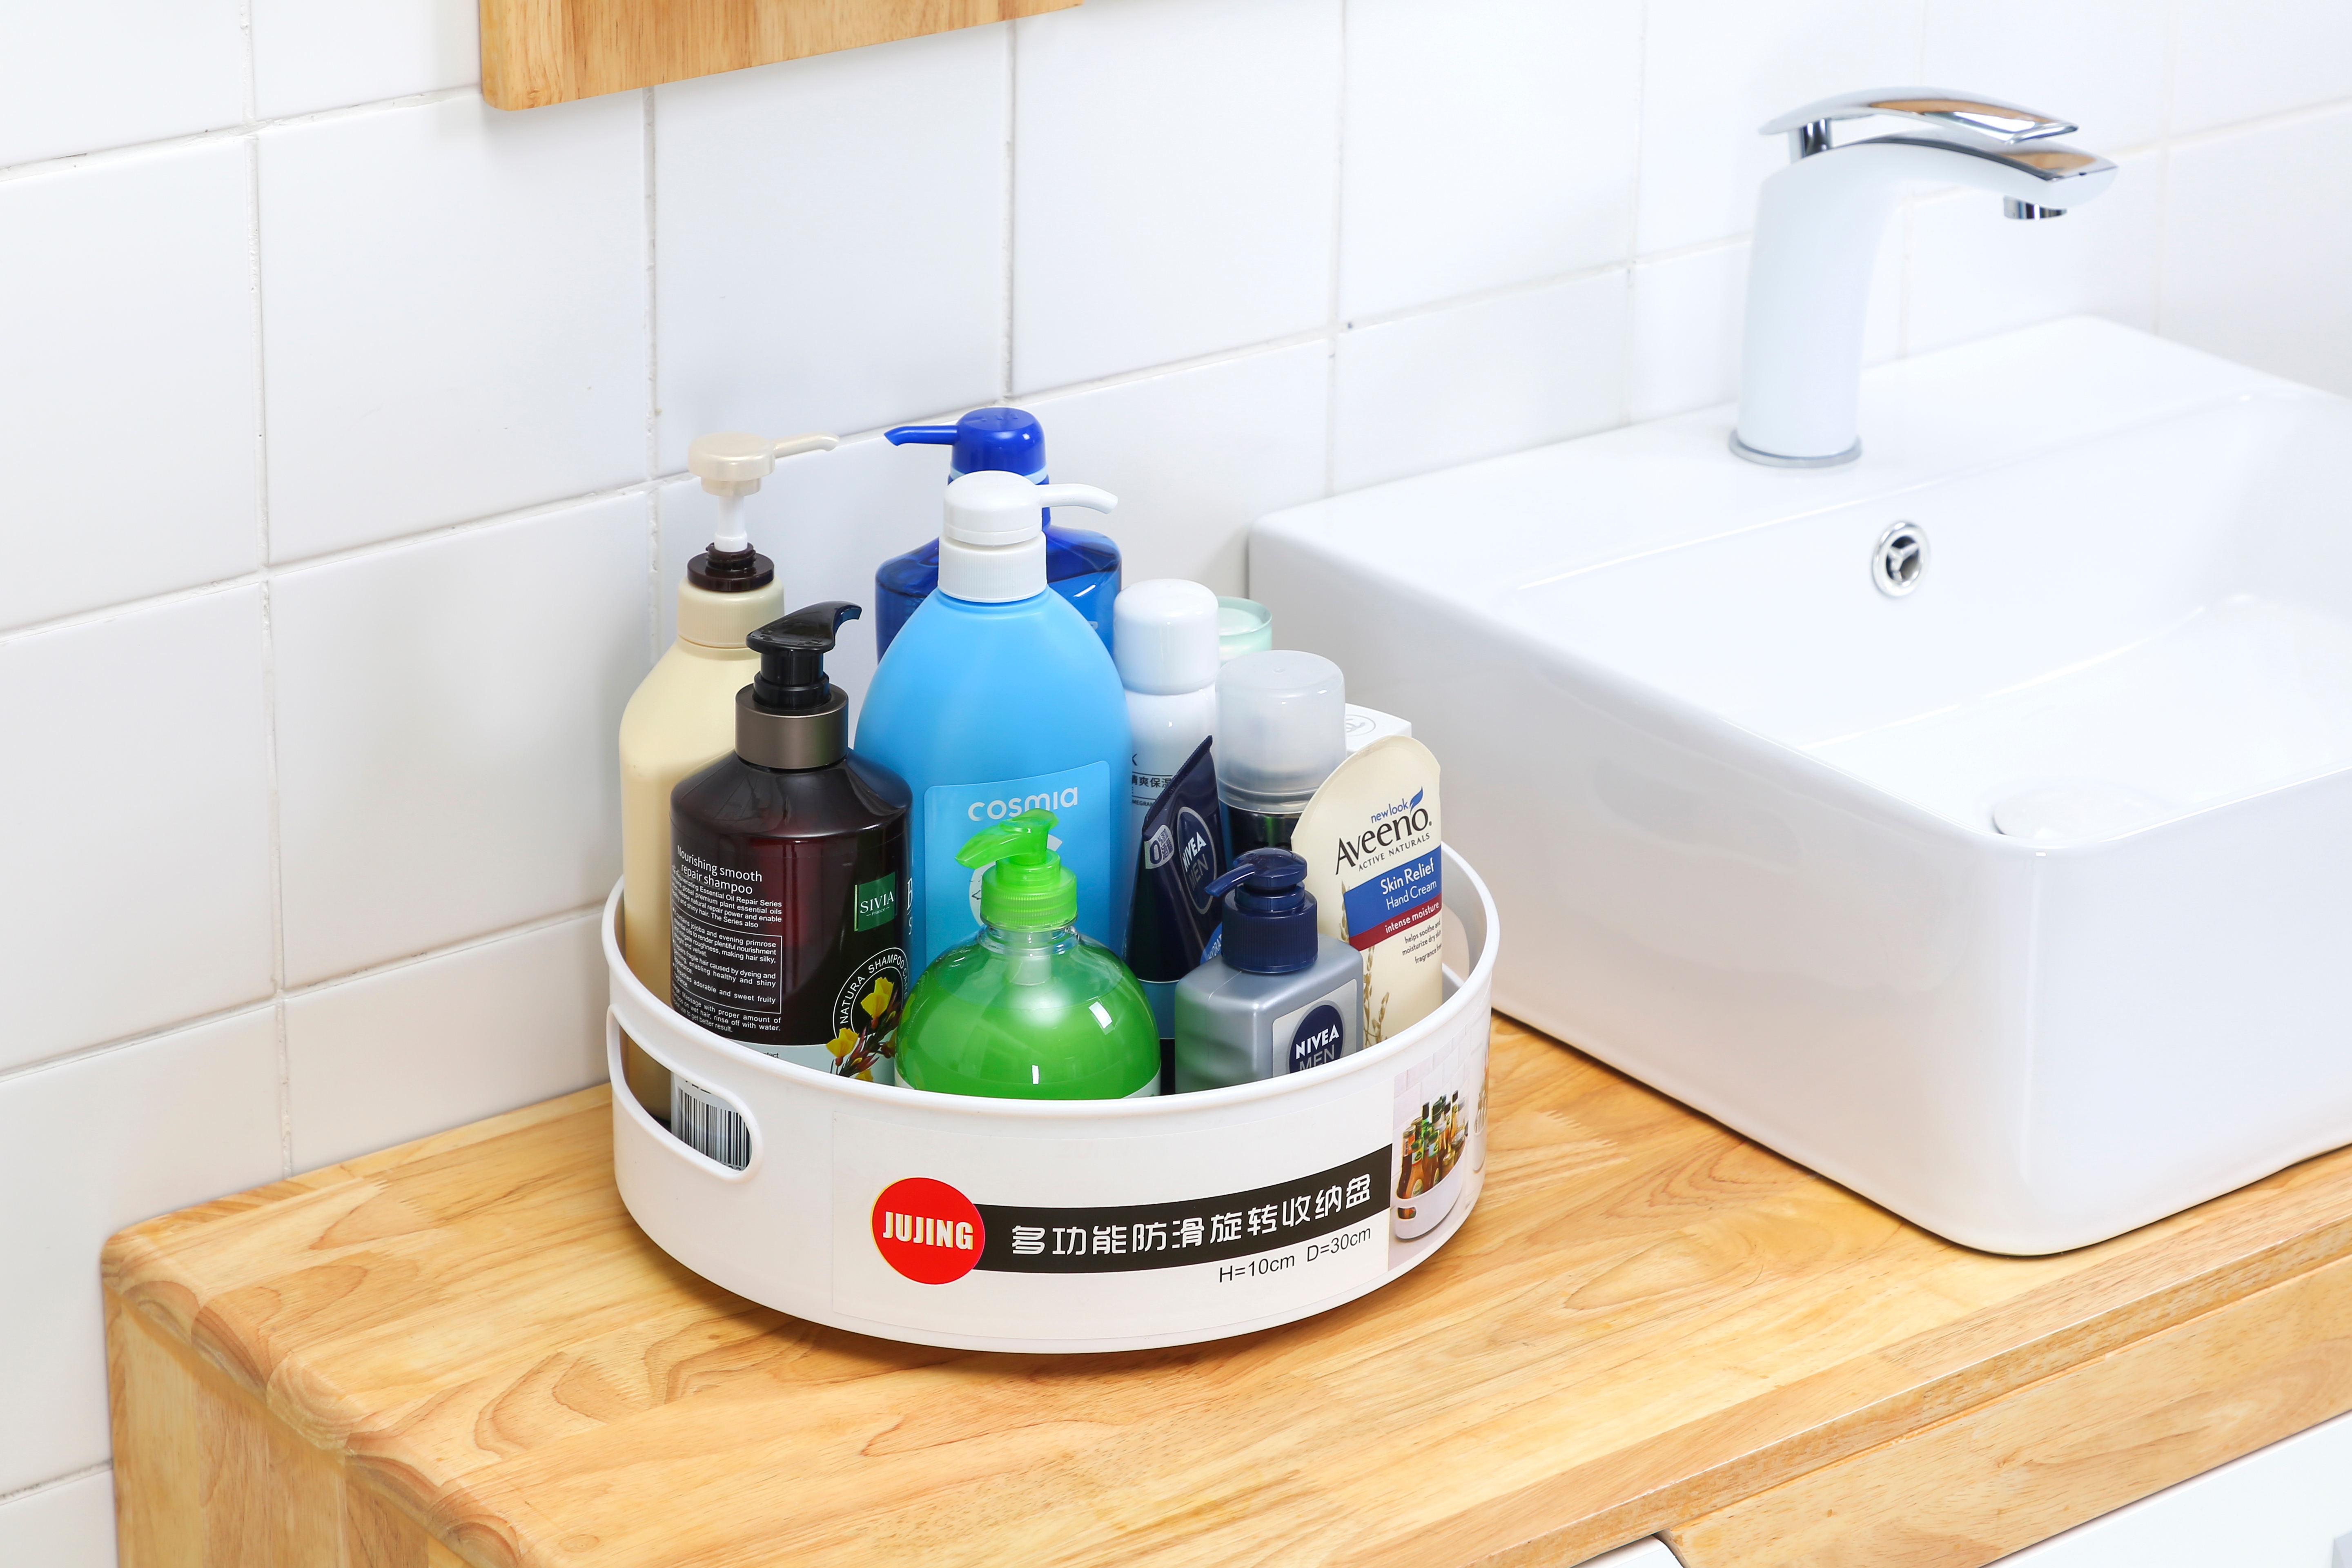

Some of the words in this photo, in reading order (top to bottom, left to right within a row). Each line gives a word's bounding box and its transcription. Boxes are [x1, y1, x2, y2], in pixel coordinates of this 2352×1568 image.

[968, 786, 1078, 821] cosmia
[1182, 832, 1207, 872] NIVEA
[1335, 808, 1428, 875] Aveeno
[1359, 853, 1385, 871] ACTIVE
[1389, 833, 1430, 856] NATURALS
[677, 845, 717, 876] Nourishing
[720, 867, 762, 882] smooth
[1381, 877, 1403, 895] Skin
[1404, 858, 1434, 884] Relief
[681, 864, 702, 881] repair
[704, 875, 753, 894] shampoo
[682, 885, 694, 895] global
[695, 893, 718, 905] premium
[720, 901, 735, 909] plant
[737, 905, 767, 913] essential
[690, 898, 706, 908] natural
[707, 905, 723, 914] repair
[724, 910, 743, 919] power
[700, 886, 724, 899] Essential
[736, 897, 758, 905] Repair
[860, 891, 894, 913] SIVIA
[1386, 890, 1409, 910] Hand
[1410, 880, 1437, 898] Cream
[699, 909, 710, 918] hair.
[711, 912, 722, 921] The
[724, 916, 743, 926] Series
[1385, 917, 1411, 933] intense
[1412, 902, 1439, 922] moisture
[691, 922, 705, 934] jojoba
[707, 930, 717, 938] and
[719, 934, 743, 944] evening
[698, 934, 713, 944] render
[715, 940, 735, 950] plentiful
[737, 946, 776, 955] nourishment
[1404, 933, 1419, 944] helps
[1419, 925, 1434, 937] soothe
[693, 940, 720, 954] roughness,
[722, 950, 744, 960] making
[1402, 940, 1428, 956] moisturize
[1415, 949, 1437, 964] fragrance
[689, 961, 710, 976] enabling
[713, 971, 736, 983] healthy
[756, 980, 776, 988] shiny
[710, 962, 730, 972] caused
[731, 968, 738, 976] by
[740, 969, 761, 979] dyeing
[693, 980, 716, 993] adorable
[757, 996, 776, 1004] fruity
[840, 976, 865, 1024] NATURA
[868, 954, 904, 973] SHAMPOO
[682, 991, 702, 1007] Massage
[704, 1003, 715, 1013] with
[718, 1010, 739, 1018] proper
[690, 1006, 699, 1014] wet
[714, 1016, 728, 1024] rinse
[699, 1016, 714, 1027] better
[715, 1023, 733, 1033] result.
[1296, 1024, 1339, 1060] NIVEA
[1012, 1173, 1371, 1255] 多功能防滑旋转收纳盘
[883, 1211, 973, 1250] JUJING
[1219, 1254, 1295, 1283] H=10cm
[1307, 1227, 1371, 1262] D=30cm
